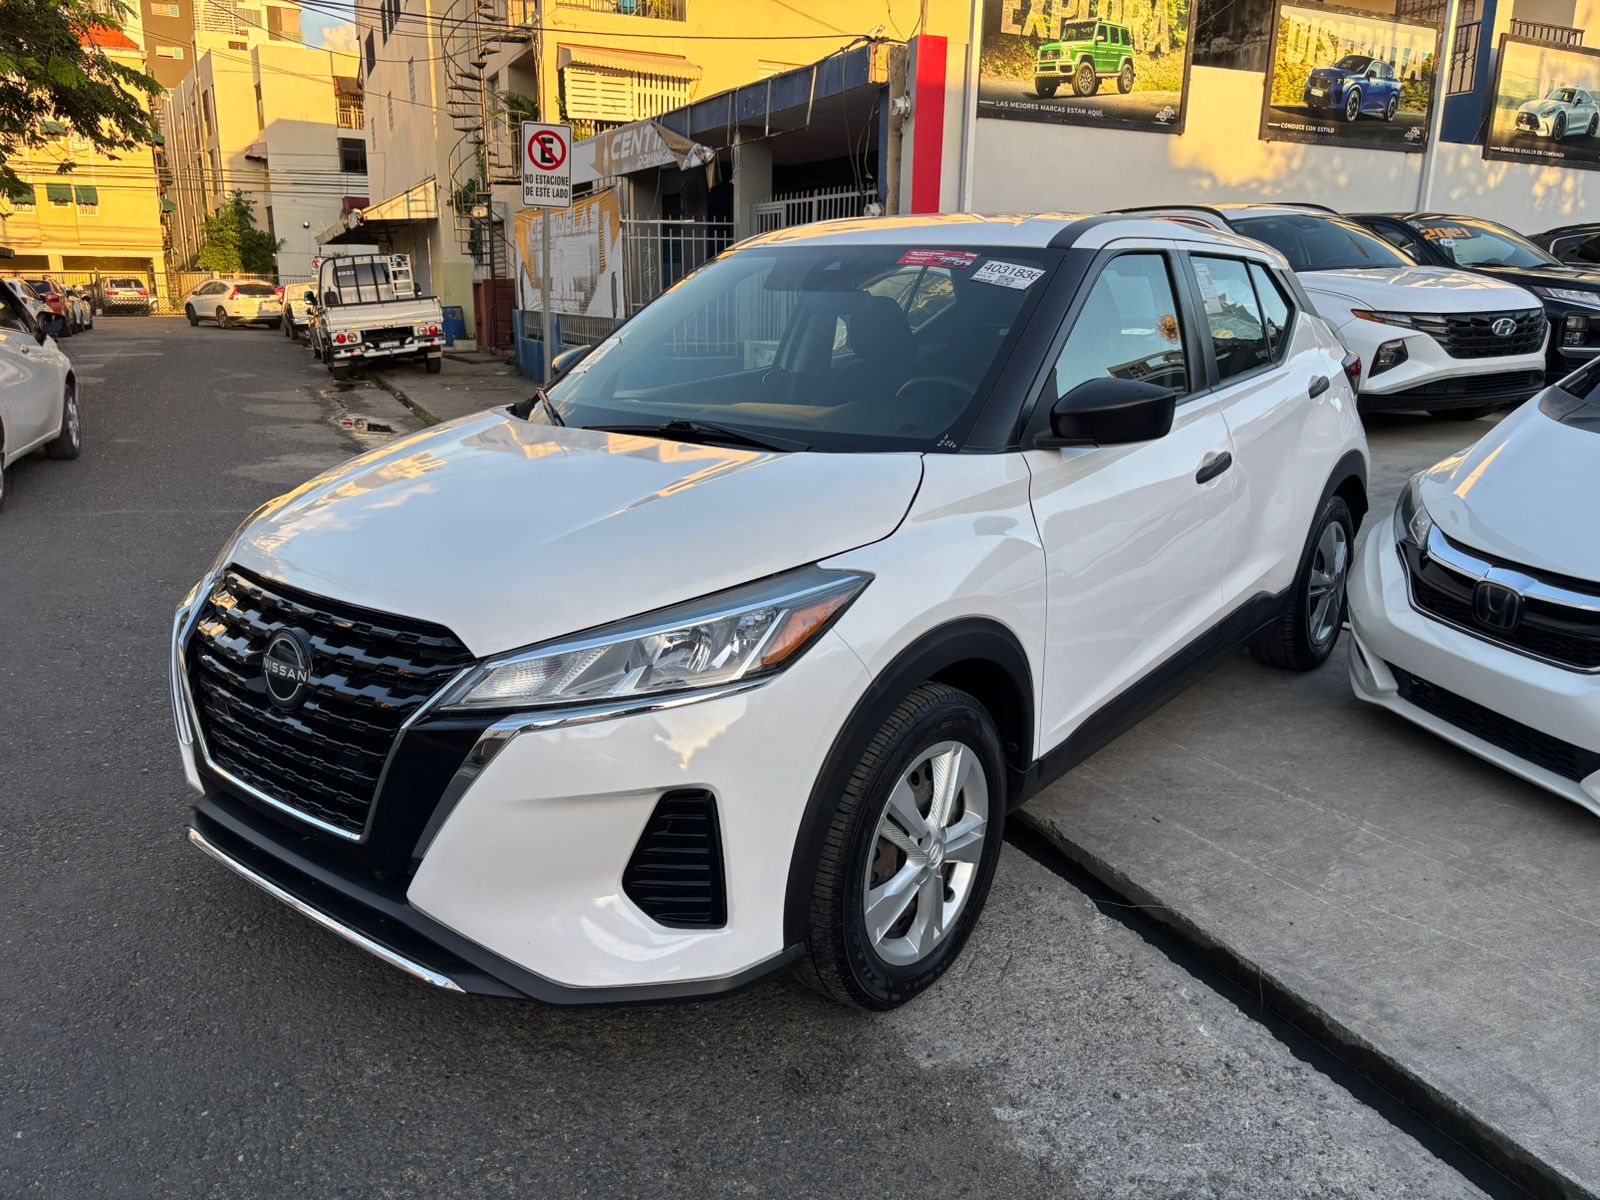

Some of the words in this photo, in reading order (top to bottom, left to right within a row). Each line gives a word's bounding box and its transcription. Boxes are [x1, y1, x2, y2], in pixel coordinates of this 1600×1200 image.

[996, 100, 1009, 108] LAS
[1010, 101, 1039, 111] MEJORES
[1040, 104, 1066, 114] MARCAS
[1067, 106, 1086, 115] ESTAN
[1280, 122, 1305, 131] CONDUCE
[1305, 124, 1317, 132] CON
[1317, 126, 1335, 134] ESTILO
[525, 174, 534, 184] NO
[535, 174, 570, 187] ESTACIONE
[525, 186, 534, 196] DE
[535, 187, 551, 198] ESTE
[552, 188, 569, 199] LADO
[984, 263, 1042, 281] 4031836
[262, 656, 307, 682] NISSAN
